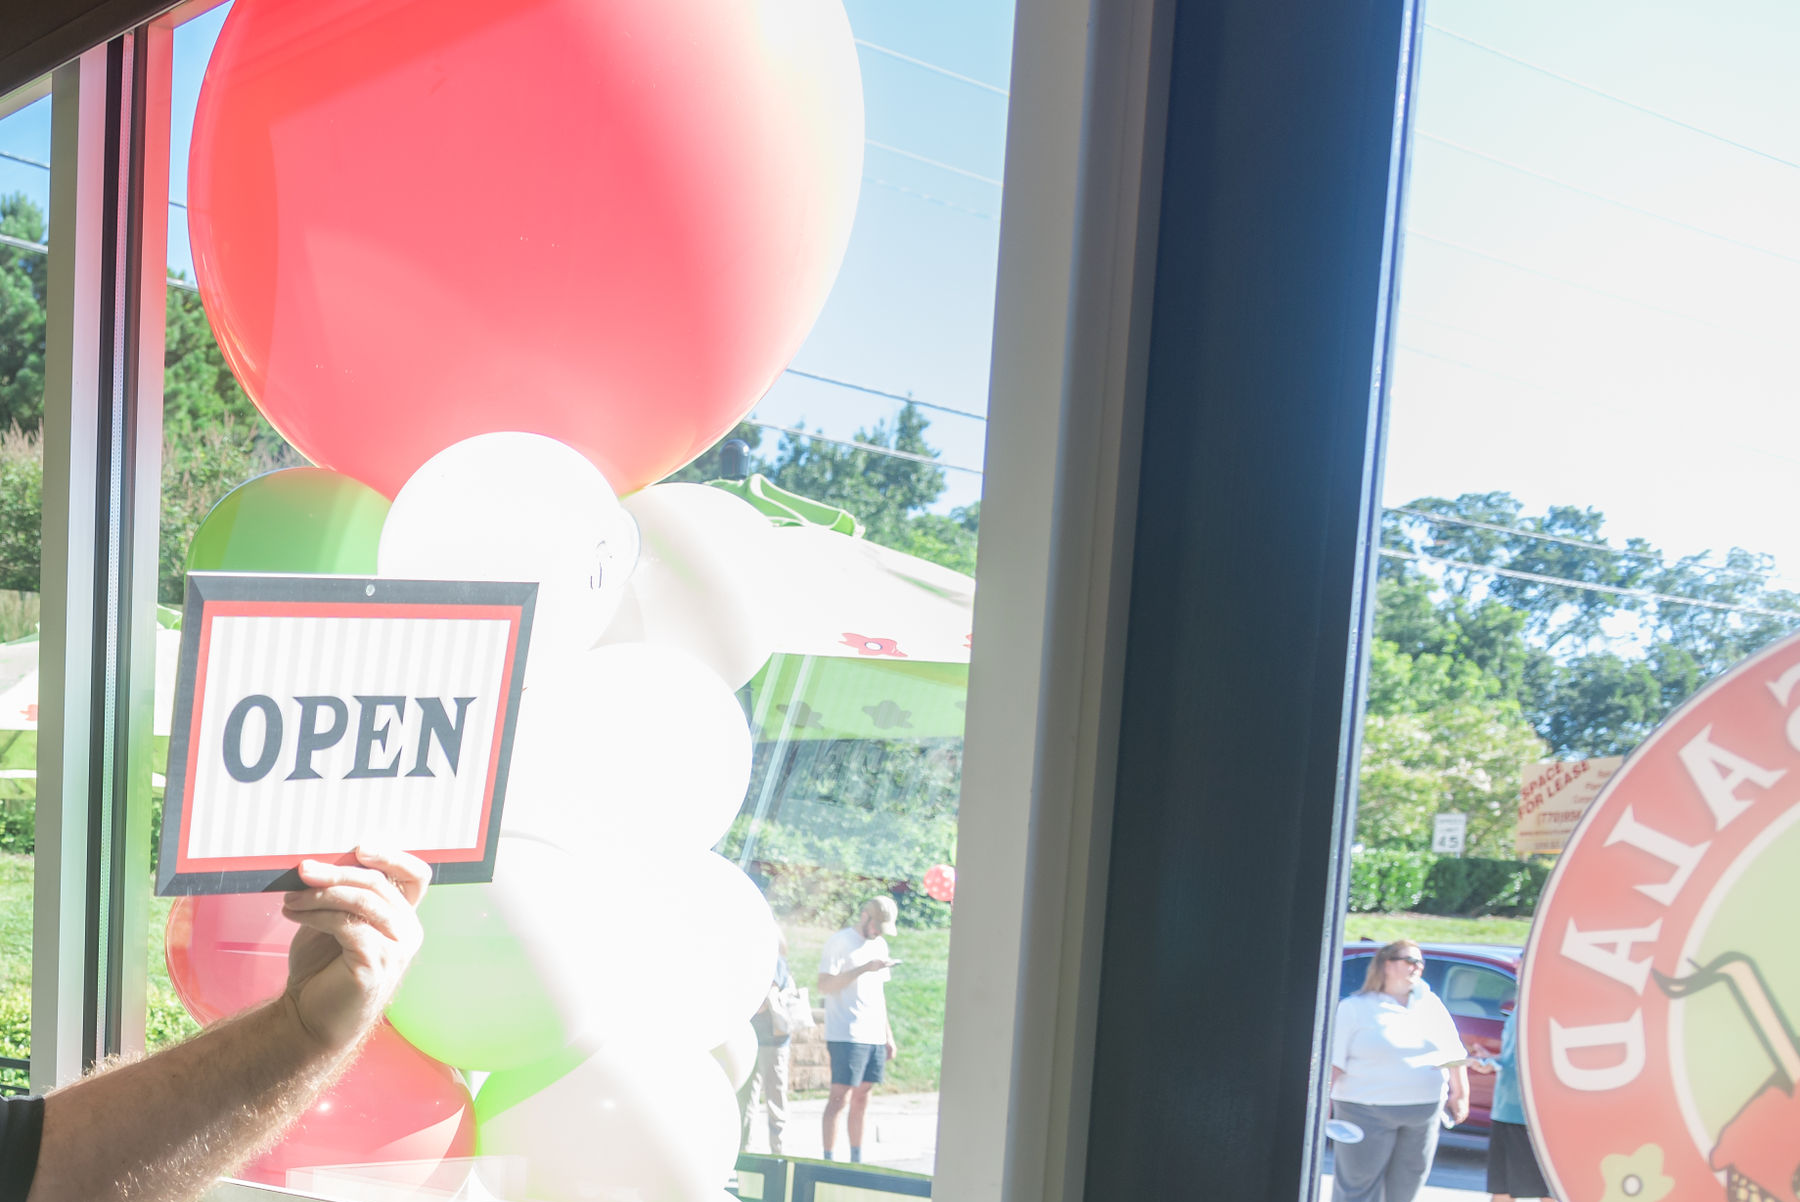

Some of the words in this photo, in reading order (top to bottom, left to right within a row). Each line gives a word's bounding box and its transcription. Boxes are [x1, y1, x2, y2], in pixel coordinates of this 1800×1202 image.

[221, 692, 478, 784] OPEN
[1517, 792, 1544, 821] FOR
[1546, 760, 1591, 798] LEASE
[1521, 760, 1564, 801] SPACE
